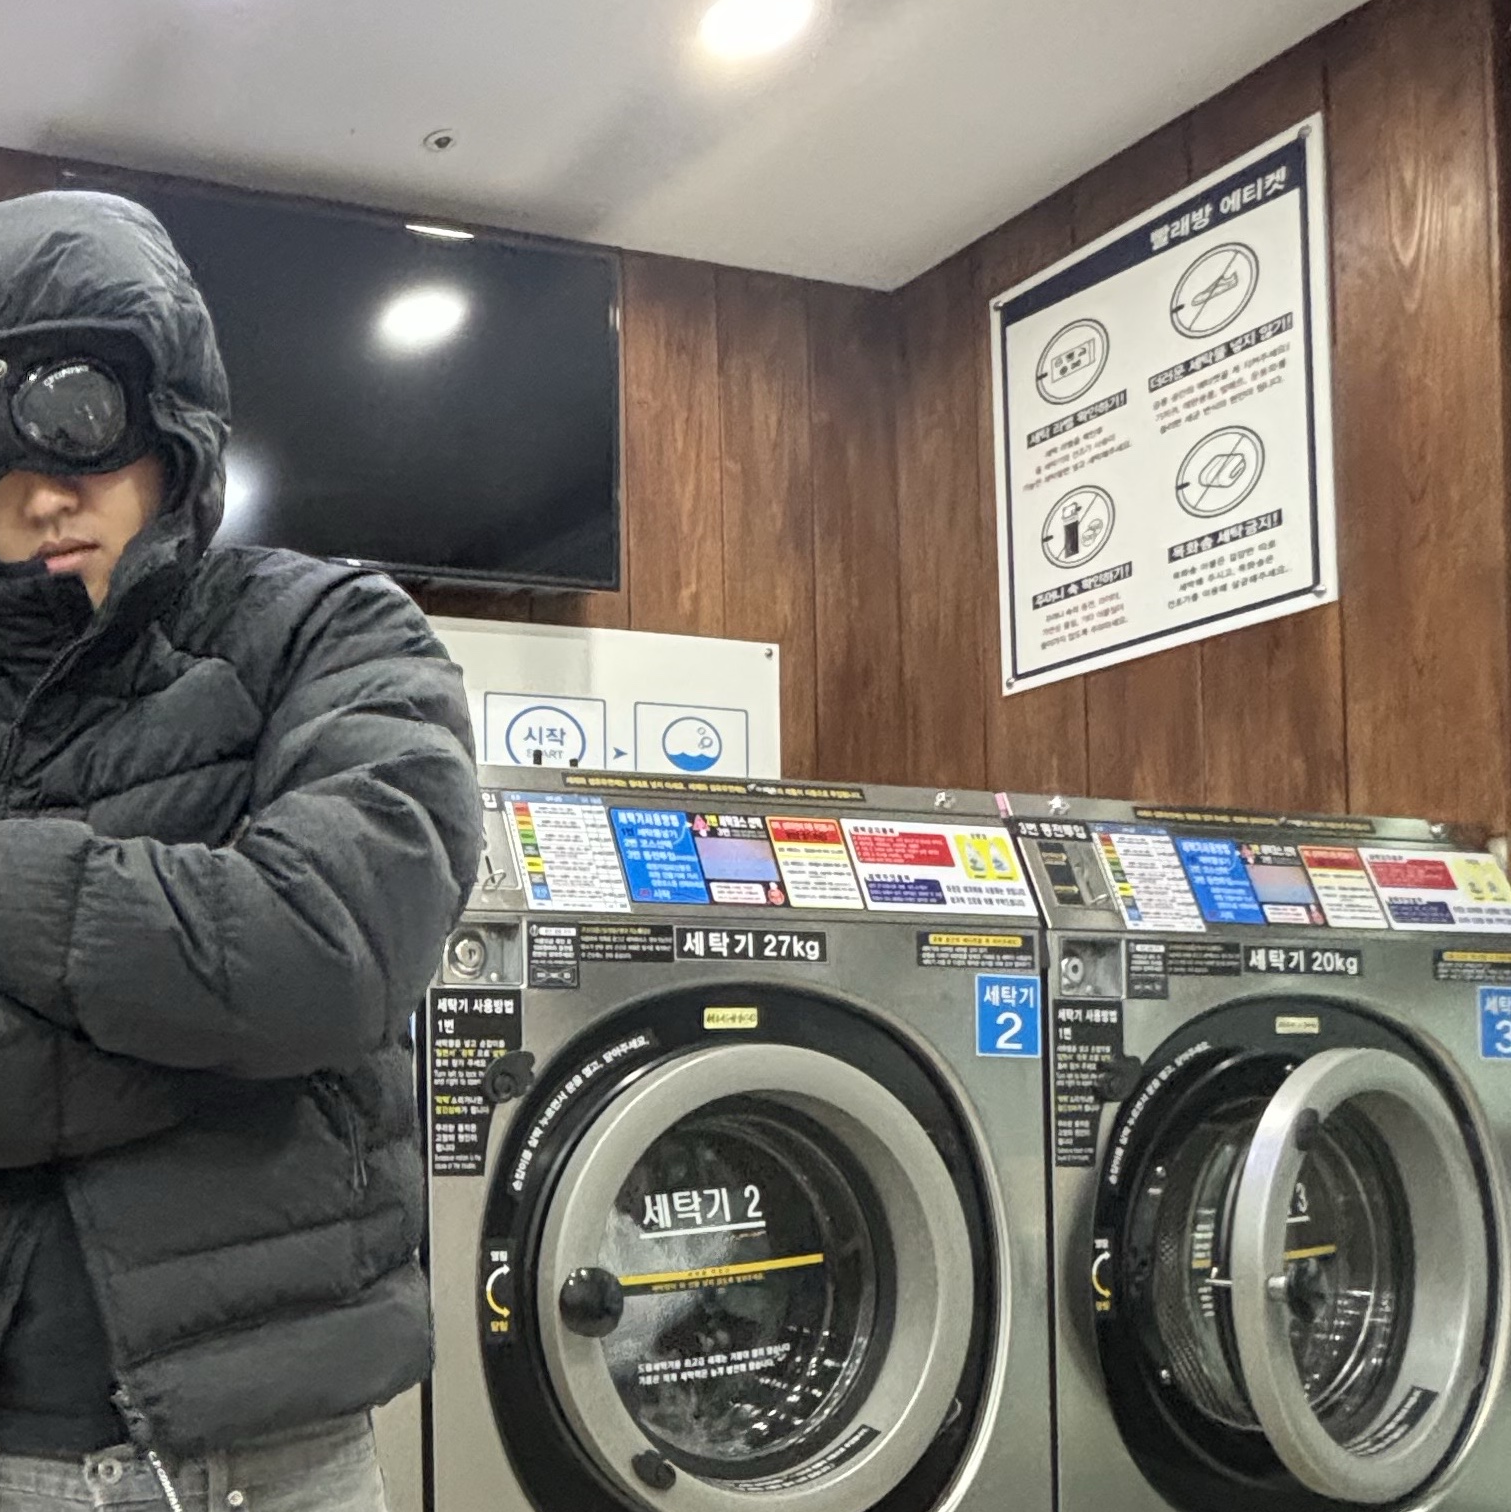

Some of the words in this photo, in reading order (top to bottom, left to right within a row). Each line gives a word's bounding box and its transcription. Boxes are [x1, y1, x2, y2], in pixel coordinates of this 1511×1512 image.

[1150, 203, 1212, 252] 빨래방
[1219, 166, 1286, 215] 에티켓
[523, 726, 567, 747] 시작
[683, 931, 755, 958] 세탁기
[763, 933, 821, 961] 27kg
[1249, 948, 1305, 973] 세탁기
[1312, 951, 1358, 975] 20kg
[437, 998, 469, 1014] 세탁기
[473, 998, 515, 1015] 사용방법
[983, 984, 1034, 1009] 세탁기
[437, 1018, 455, 1034] 1번
[996, 1011, 1023, 1051] 2
[643, 1186, 731, 1228] 세탁기
[743, 1184, 763, 1218] 2
